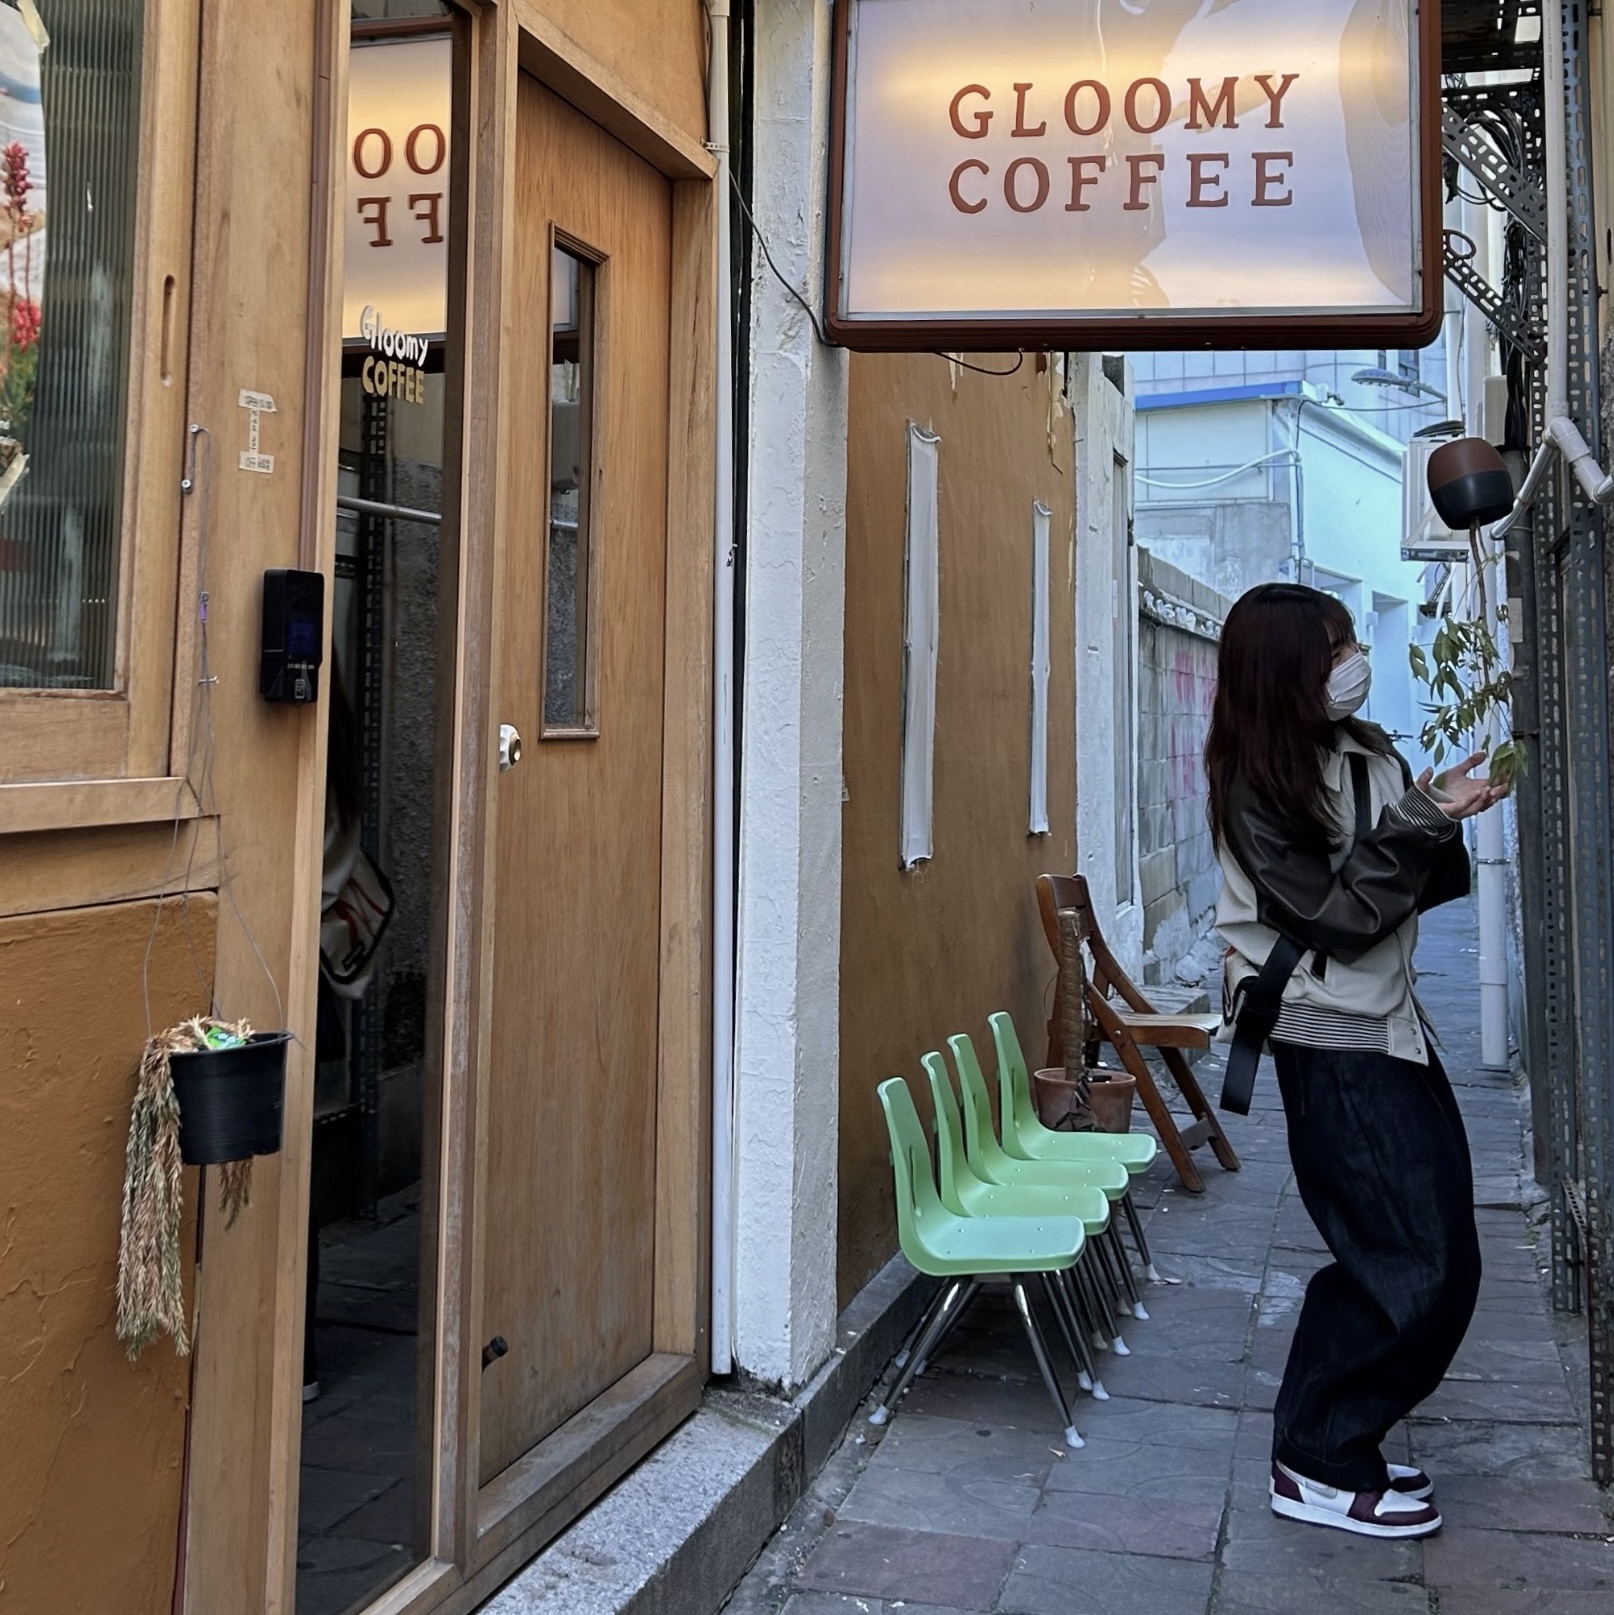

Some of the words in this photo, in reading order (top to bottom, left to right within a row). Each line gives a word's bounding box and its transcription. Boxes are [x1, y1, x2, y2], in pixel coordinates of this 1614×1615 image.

[950, 75, 1299, 139] GLOOMY
[949, 153, 1293, 213] COFFEE
[360, 305, 428, 366] Gloomy
[362, 355, 425, 404] COFFEE
